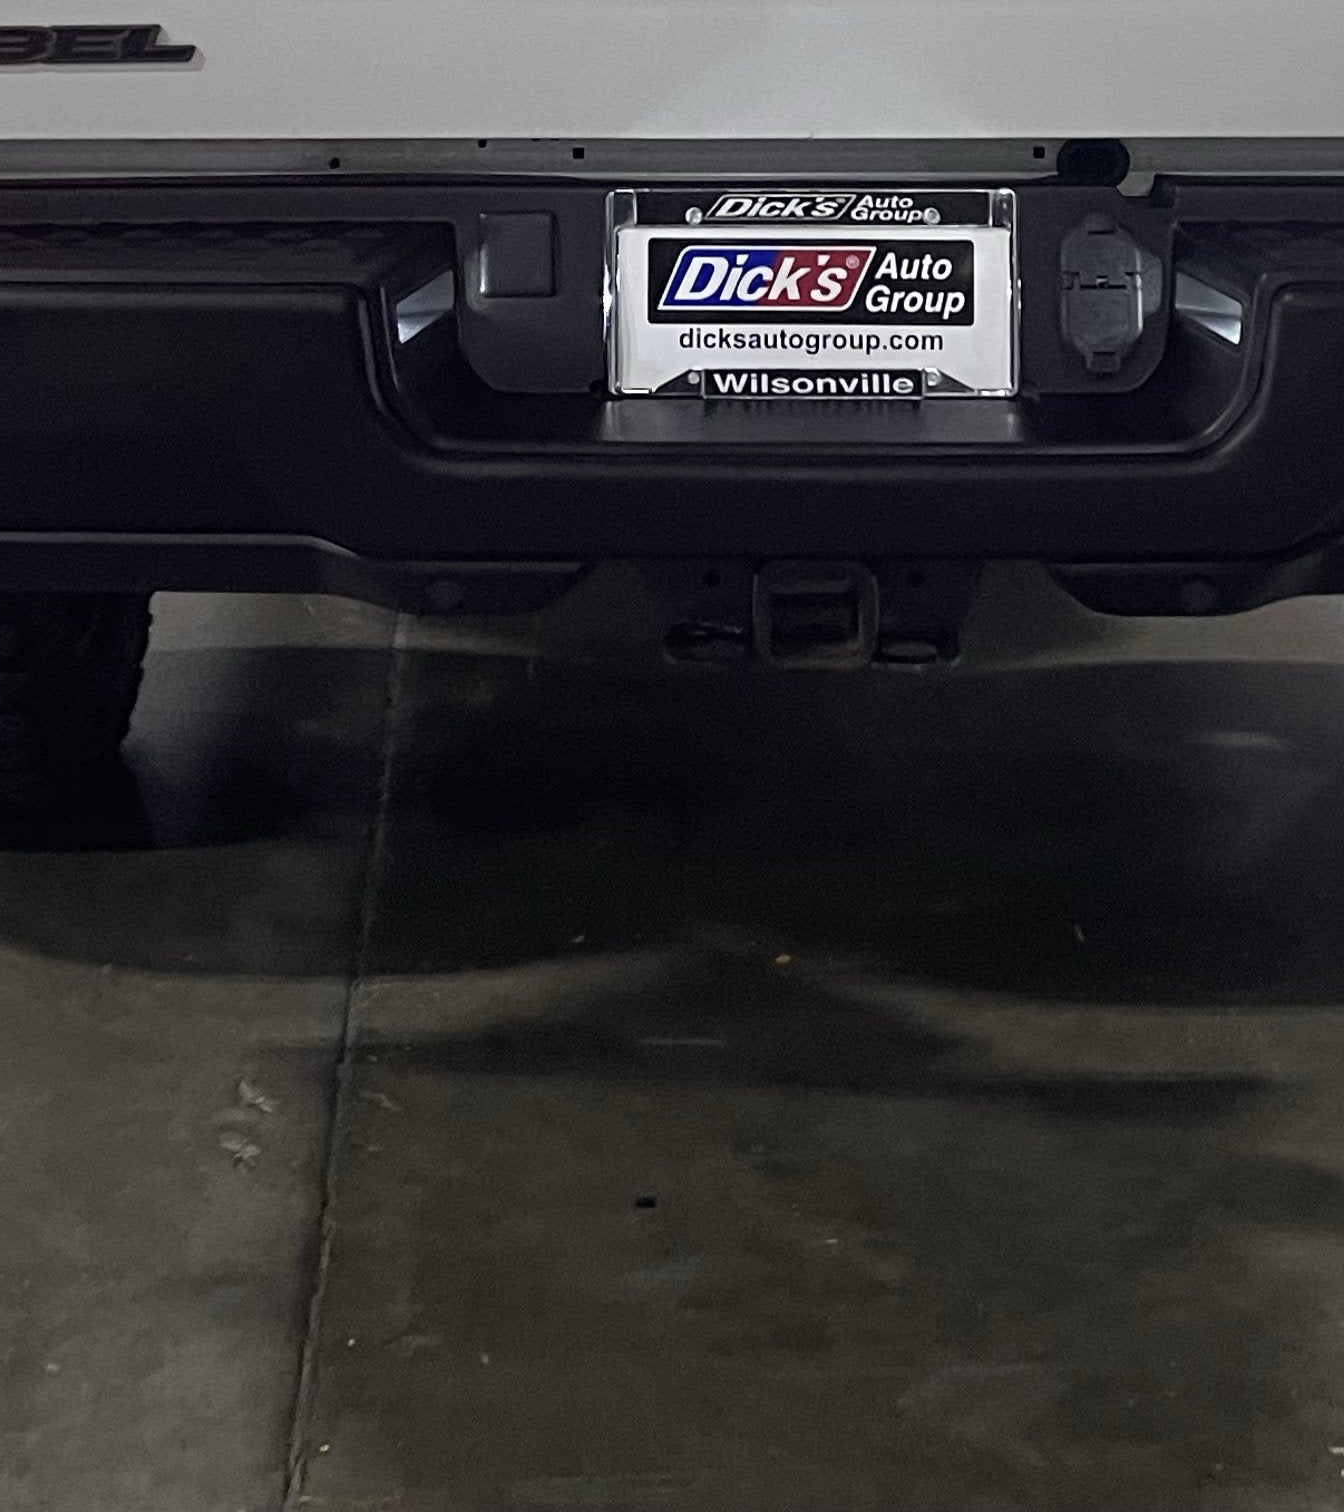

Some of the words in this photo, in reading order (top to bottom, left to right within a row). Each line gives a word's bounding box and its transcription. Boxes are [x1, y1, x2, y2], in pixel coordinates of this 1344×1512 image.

[715, 196, 840, 218] Dick's
[856, 194, 914, 209] Auto
[850, 207, 923, 224] Group
[673, 253, 850, 302] Dick's
[875, 252, 953, 281] Auto
[864, 284, 965, 320] Group
[678, 327, 944, 354] dicksautogroup.com
[713, 372, 915, 395] Wilsonville
